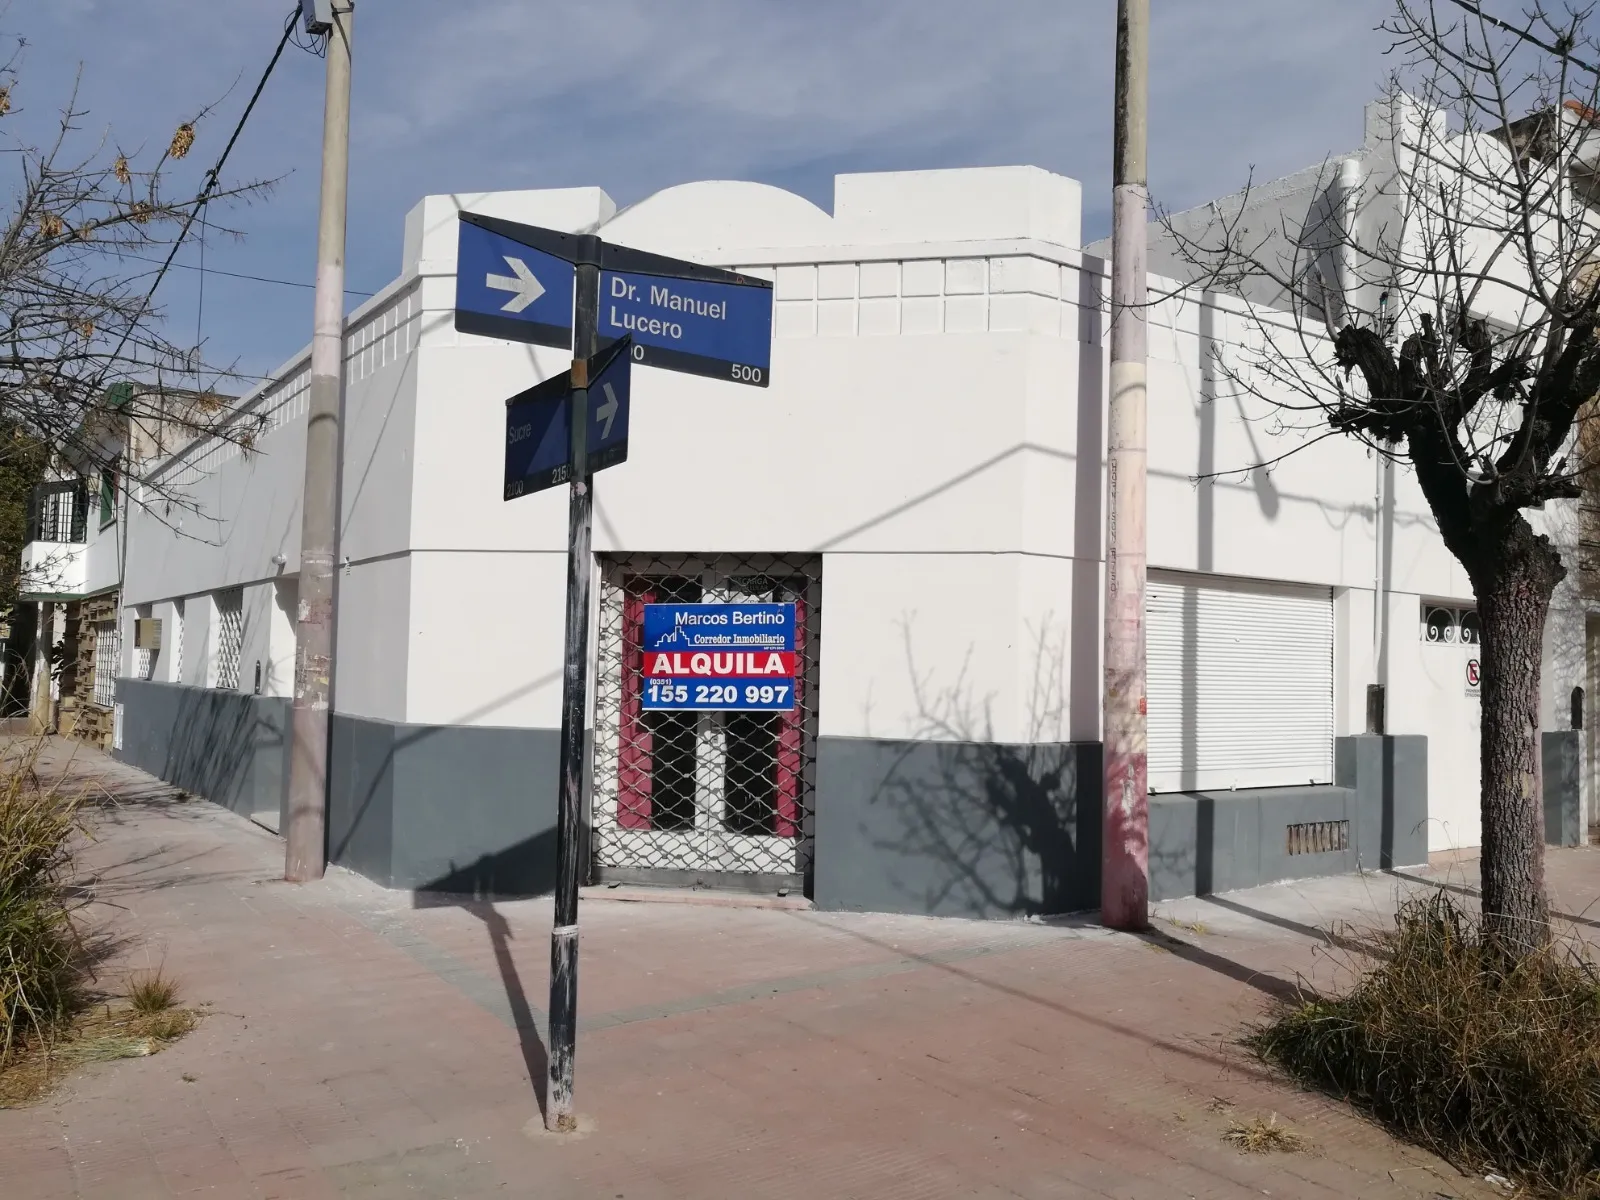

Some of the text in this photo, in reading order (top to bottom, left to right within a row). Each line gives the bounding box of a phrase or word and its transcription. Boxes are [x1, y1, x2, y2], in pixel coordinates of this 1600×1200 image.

[611, 277, 727, 320] Dr. Manuel
[611, 306, 682, 338] Lucero
[731, 364, 762, 383] 500
[508, 423, 532, 444] Sucre
[506, 480, 524, 497] 2100
[675, 611, 785, 625] Marcos Bertino
[694, 634, 785, 644] Corredor Inmobiliario
[652, 653, 785, 676] ALQUILA
[648, 685, 789, 703] 155 220 997
